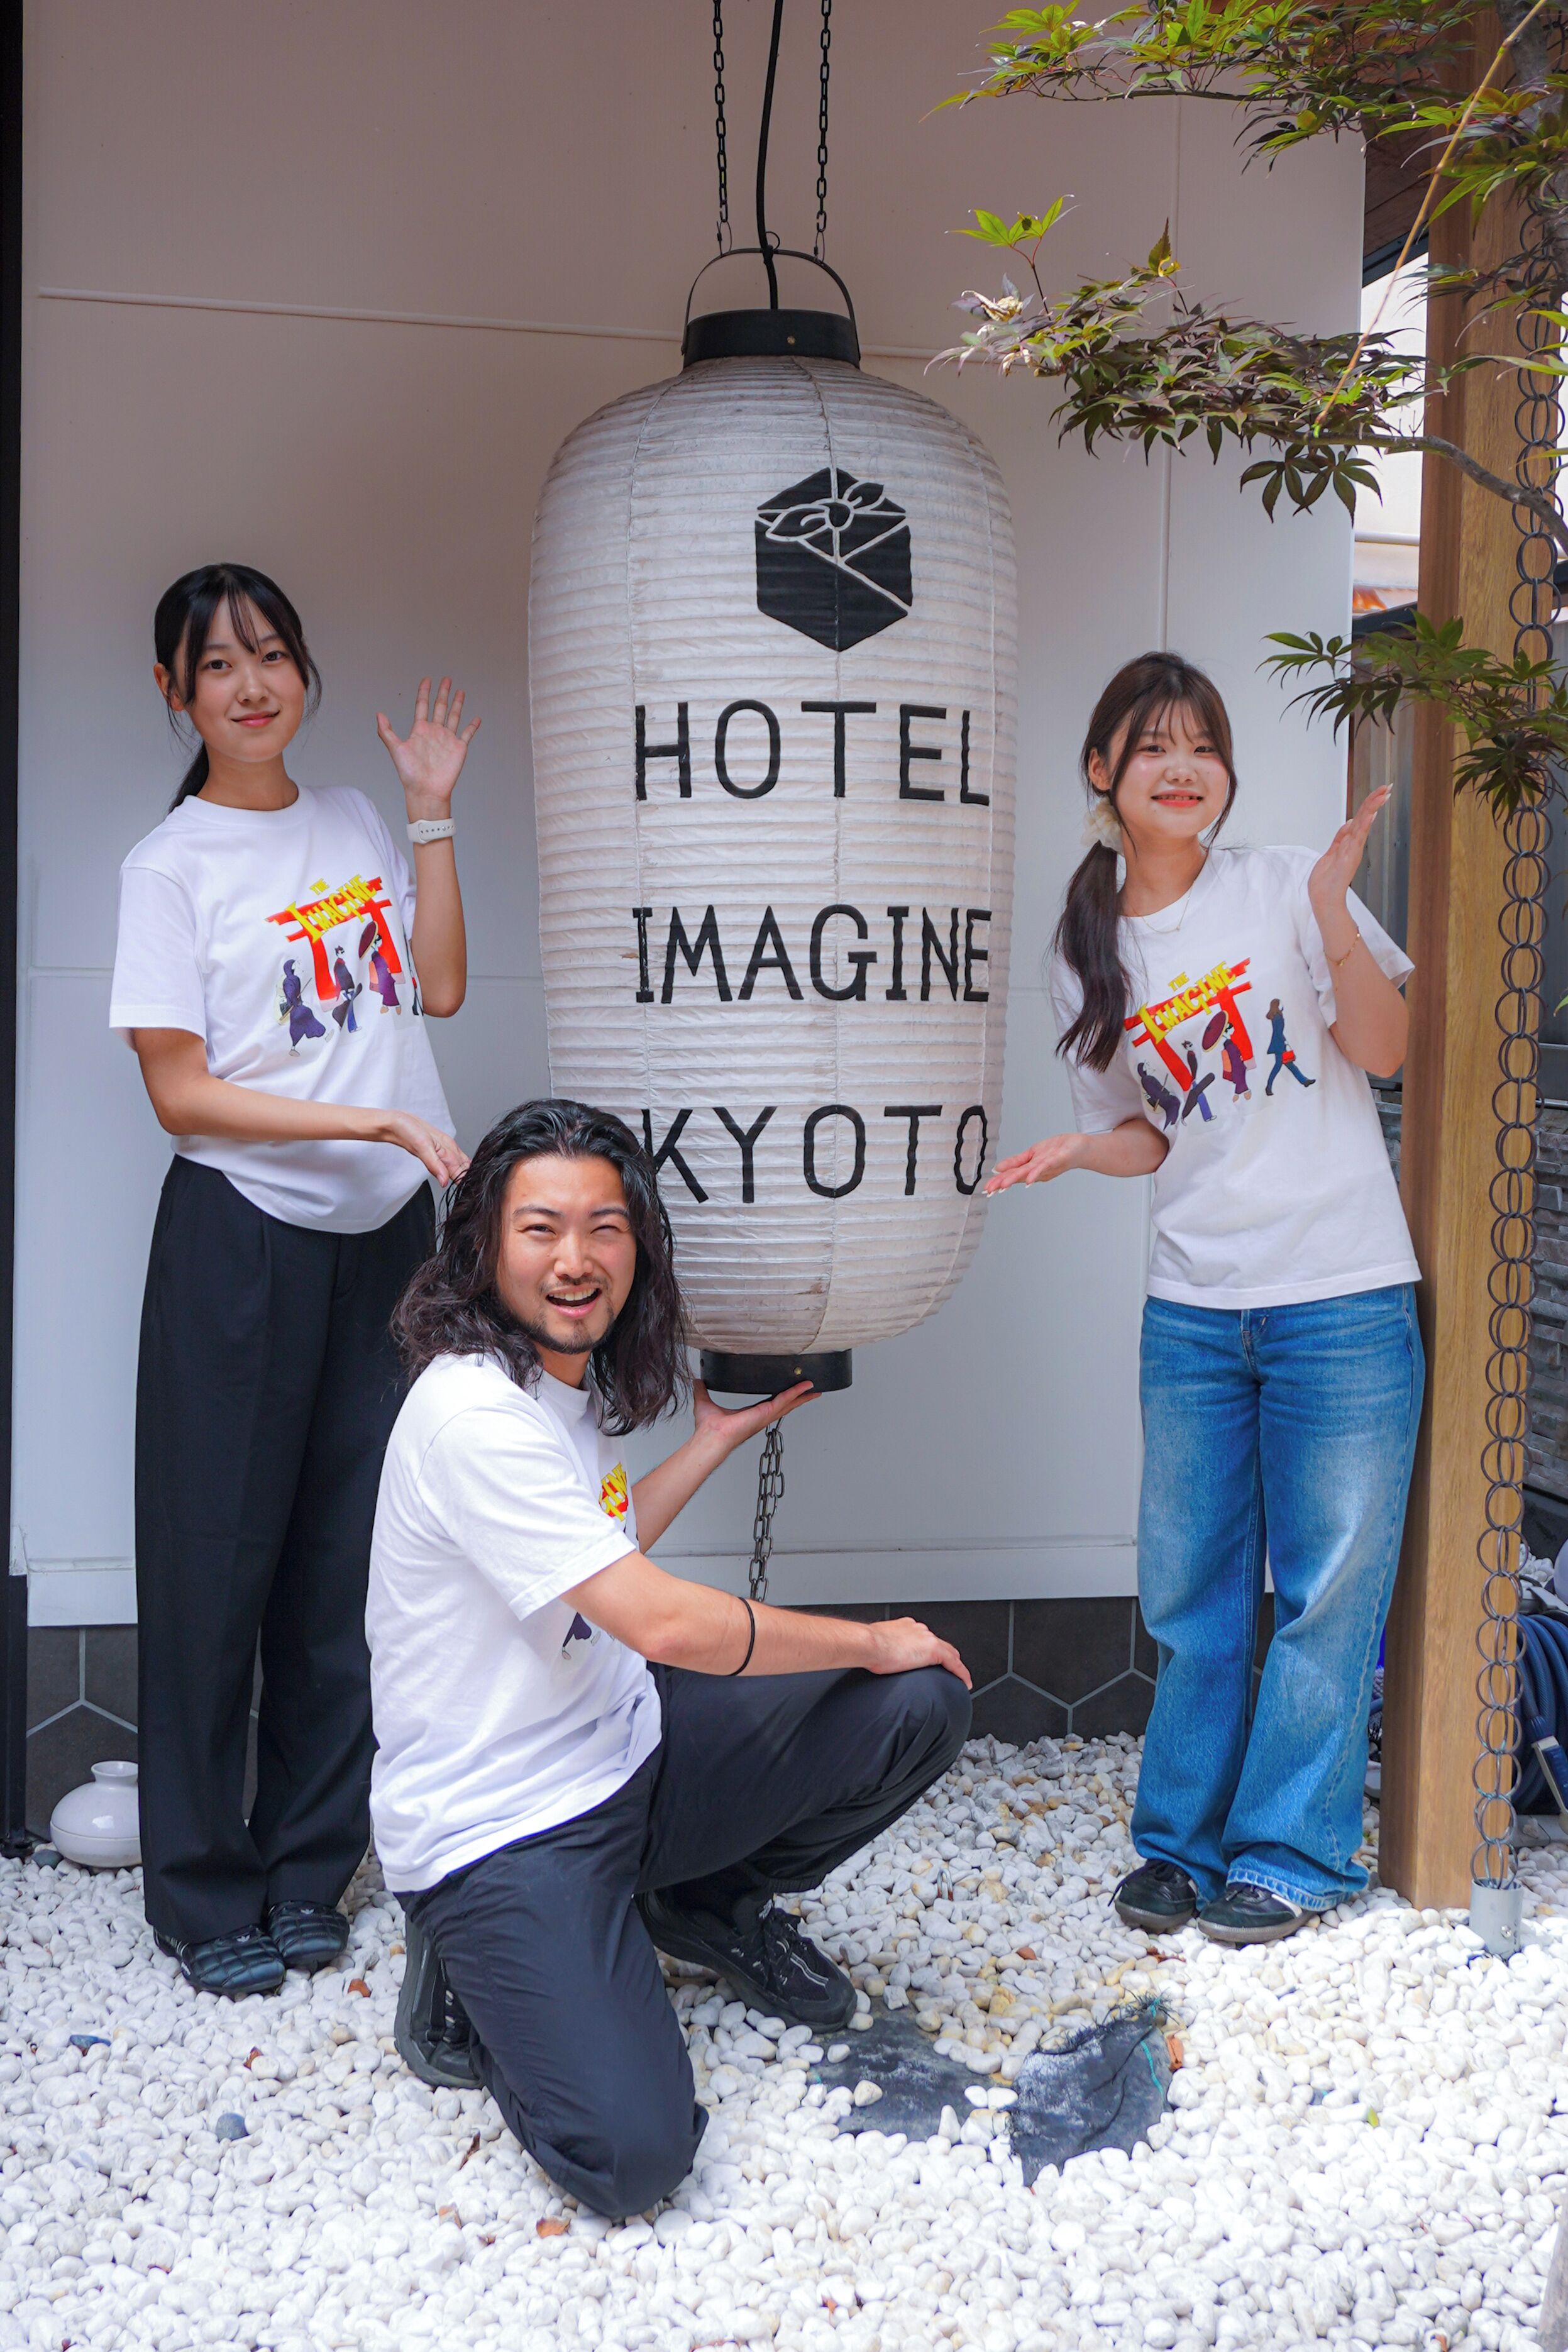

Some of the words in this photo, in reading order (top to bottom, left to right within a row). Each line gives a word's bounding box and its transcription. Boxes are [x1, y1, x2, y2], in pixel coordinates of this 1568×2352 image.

[635, 699, 991, 807] HOTEL
[284, 874, 377, 942] IMAGINE
[309, 878, 329, 896] THE
[632, 903, 992, 1004] IMAGINE
[1168, 971, 1190, 992] THE
[1137, 961, 1237, 1044] IMAGINE
[641, 1104, 988, 1204] KYOTO
